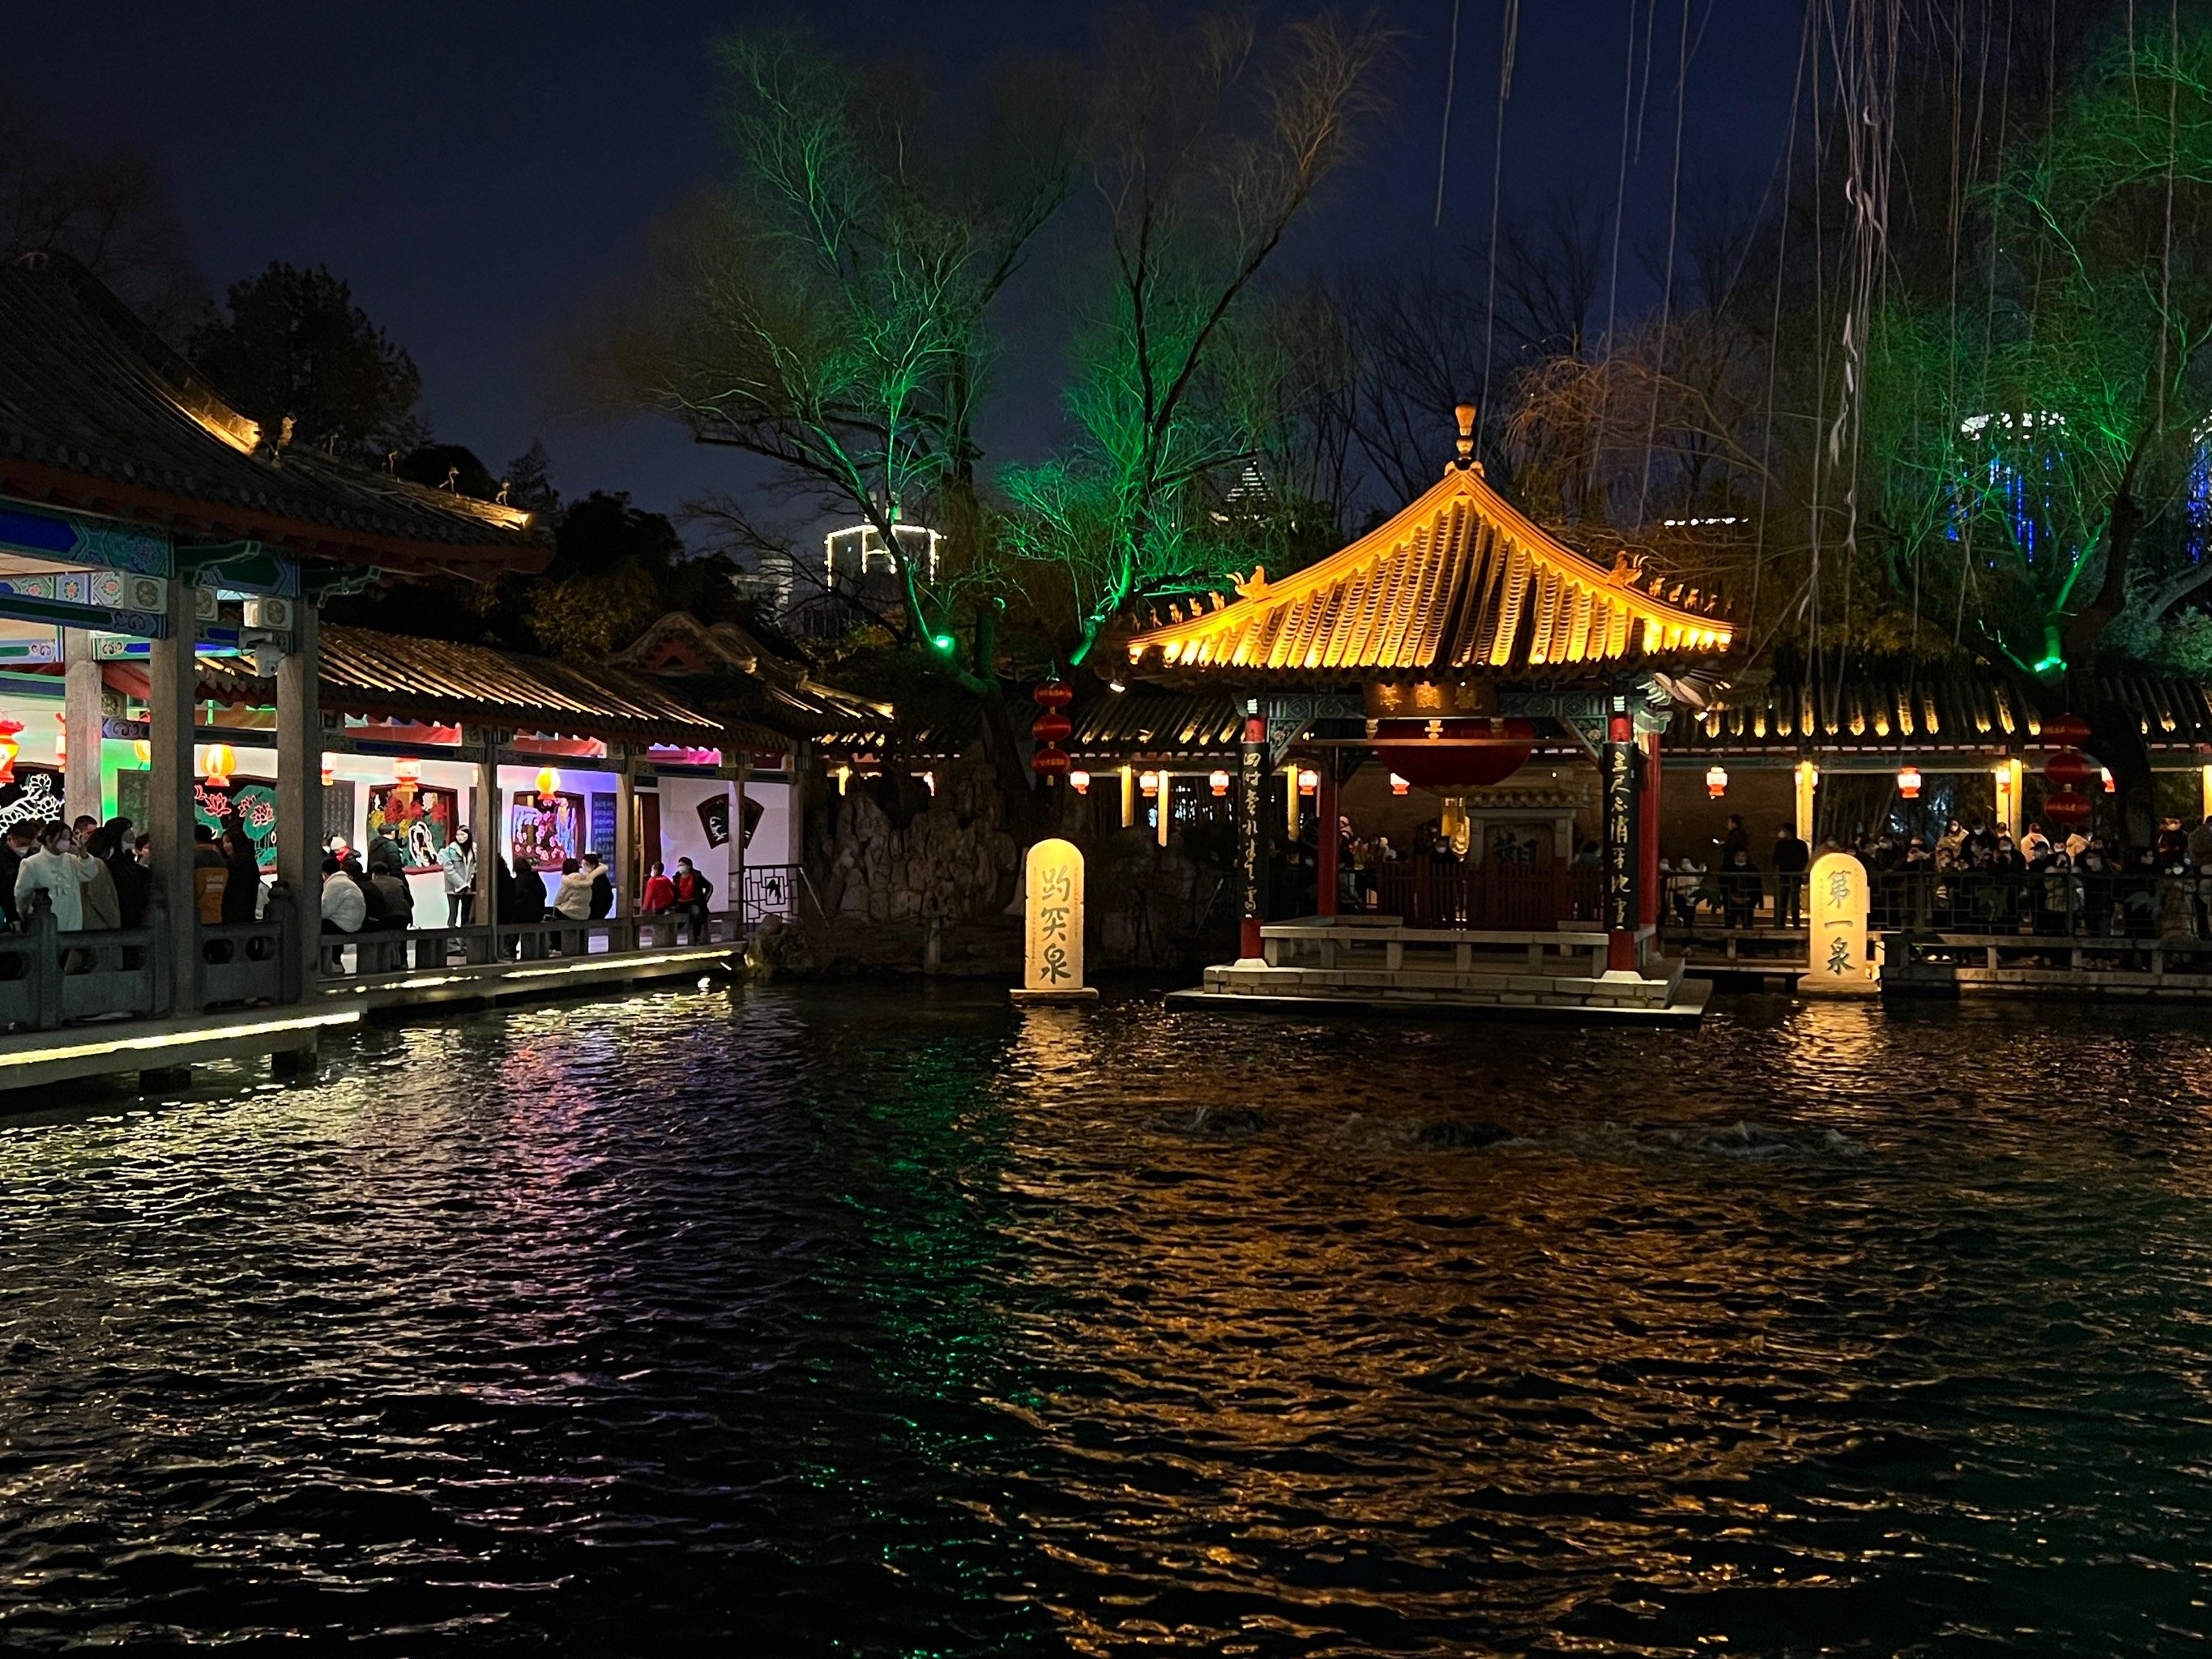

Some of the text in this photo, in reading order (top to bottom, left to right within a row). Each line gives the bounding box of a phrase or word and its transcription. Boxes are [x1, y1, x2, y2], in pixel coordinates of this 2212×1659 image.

[1040, 865, 1071, 985] 趵突泉
[1824, 870, 1856, 976] 第一泉
